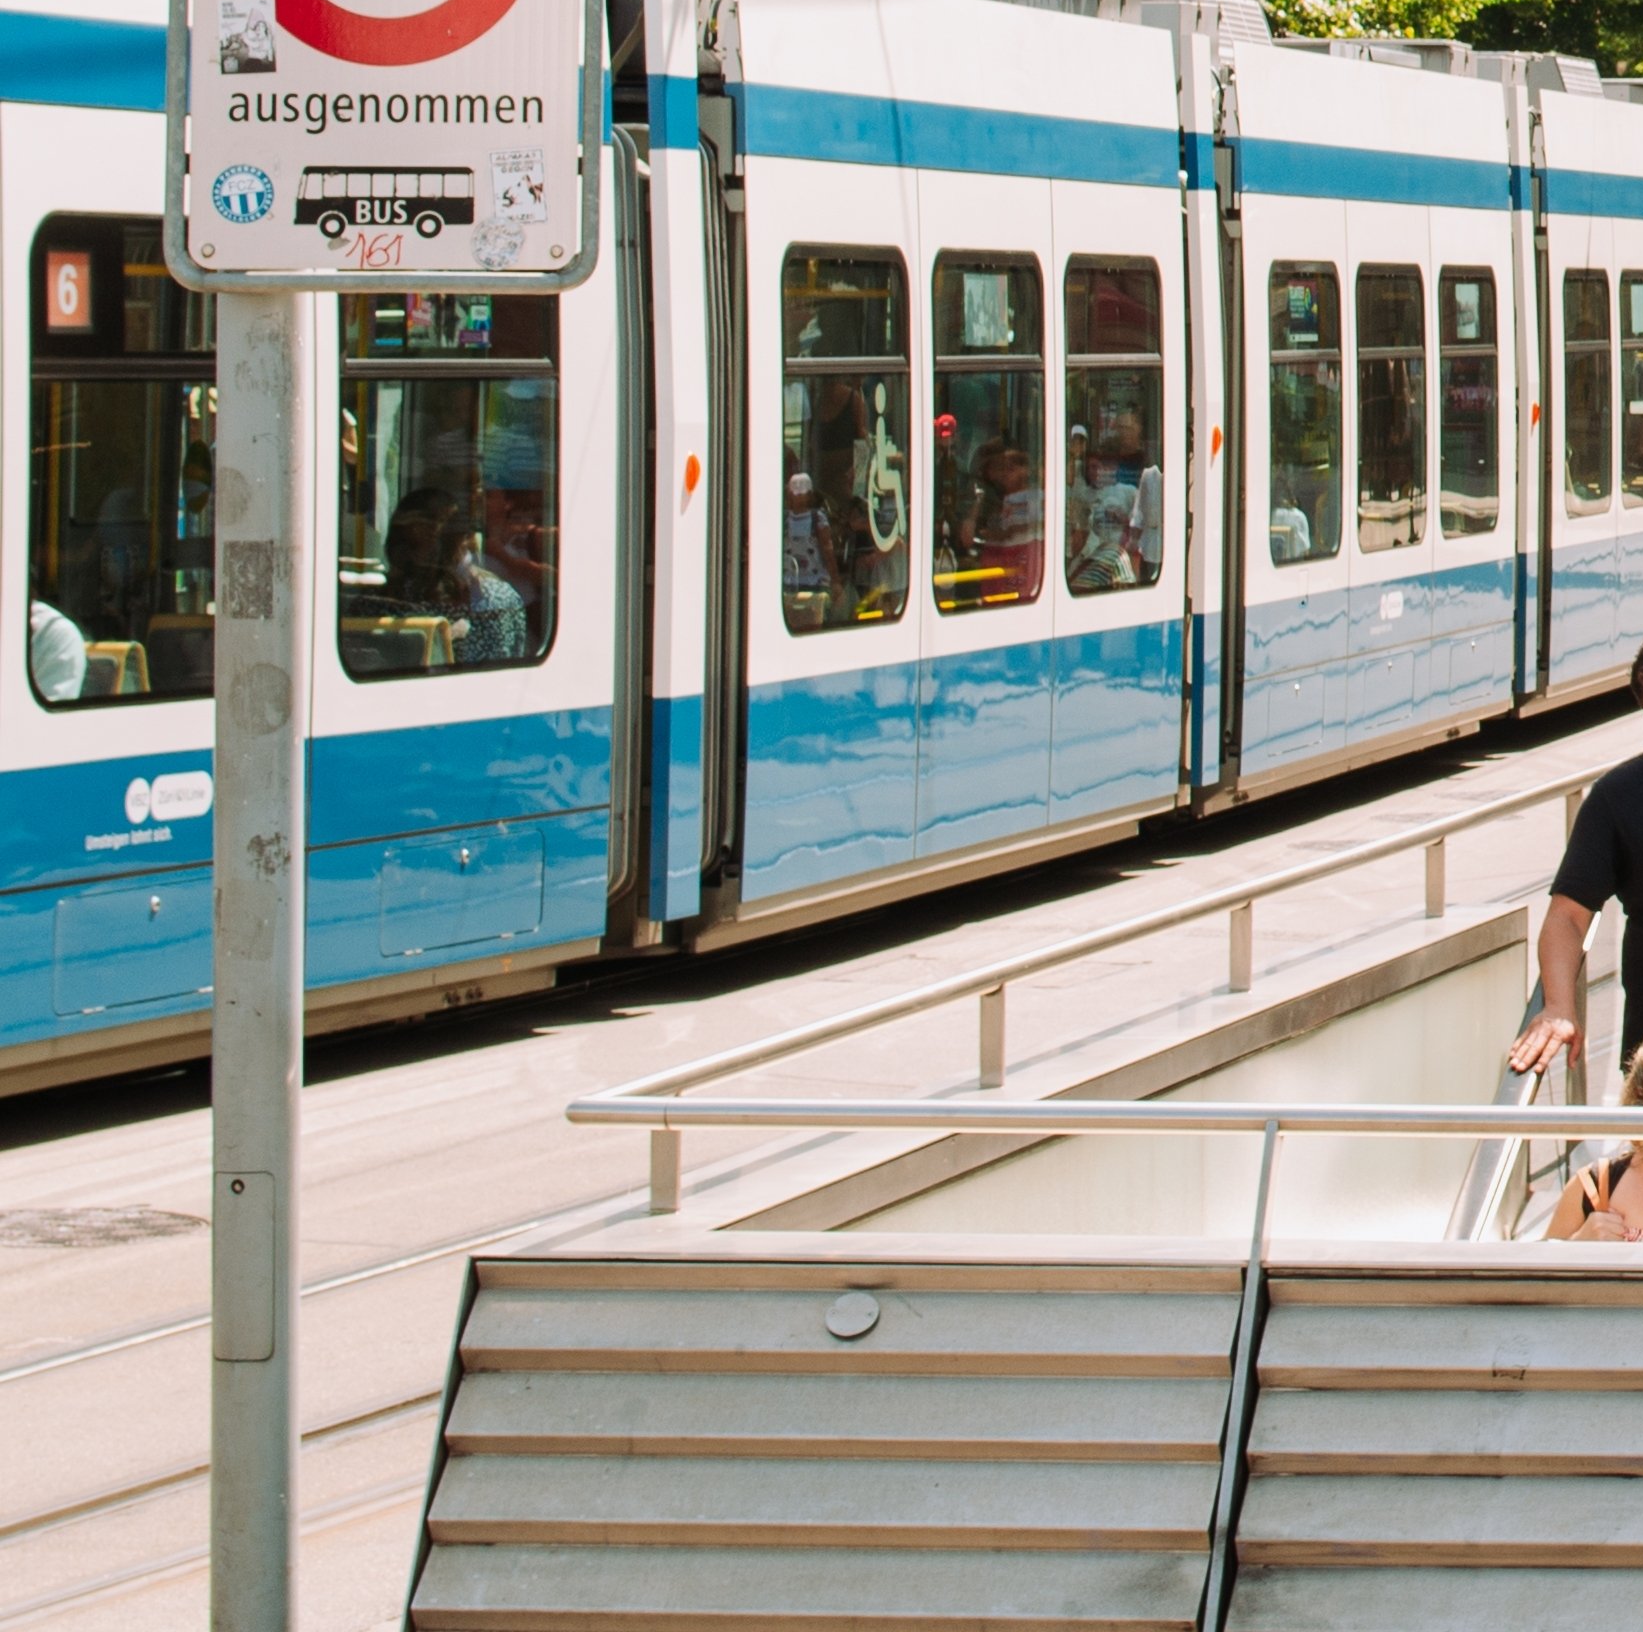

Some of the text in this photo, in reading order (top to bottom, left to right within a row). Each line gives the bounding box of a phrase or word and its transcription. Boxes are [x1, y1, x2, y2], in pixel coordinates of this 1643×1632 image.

[228, 92, 544, 135] ausgenommen
[355, 199, 408, 225] BUS
[345, 231, 404, 269] 161
[58, 263, 79, 315] 6
